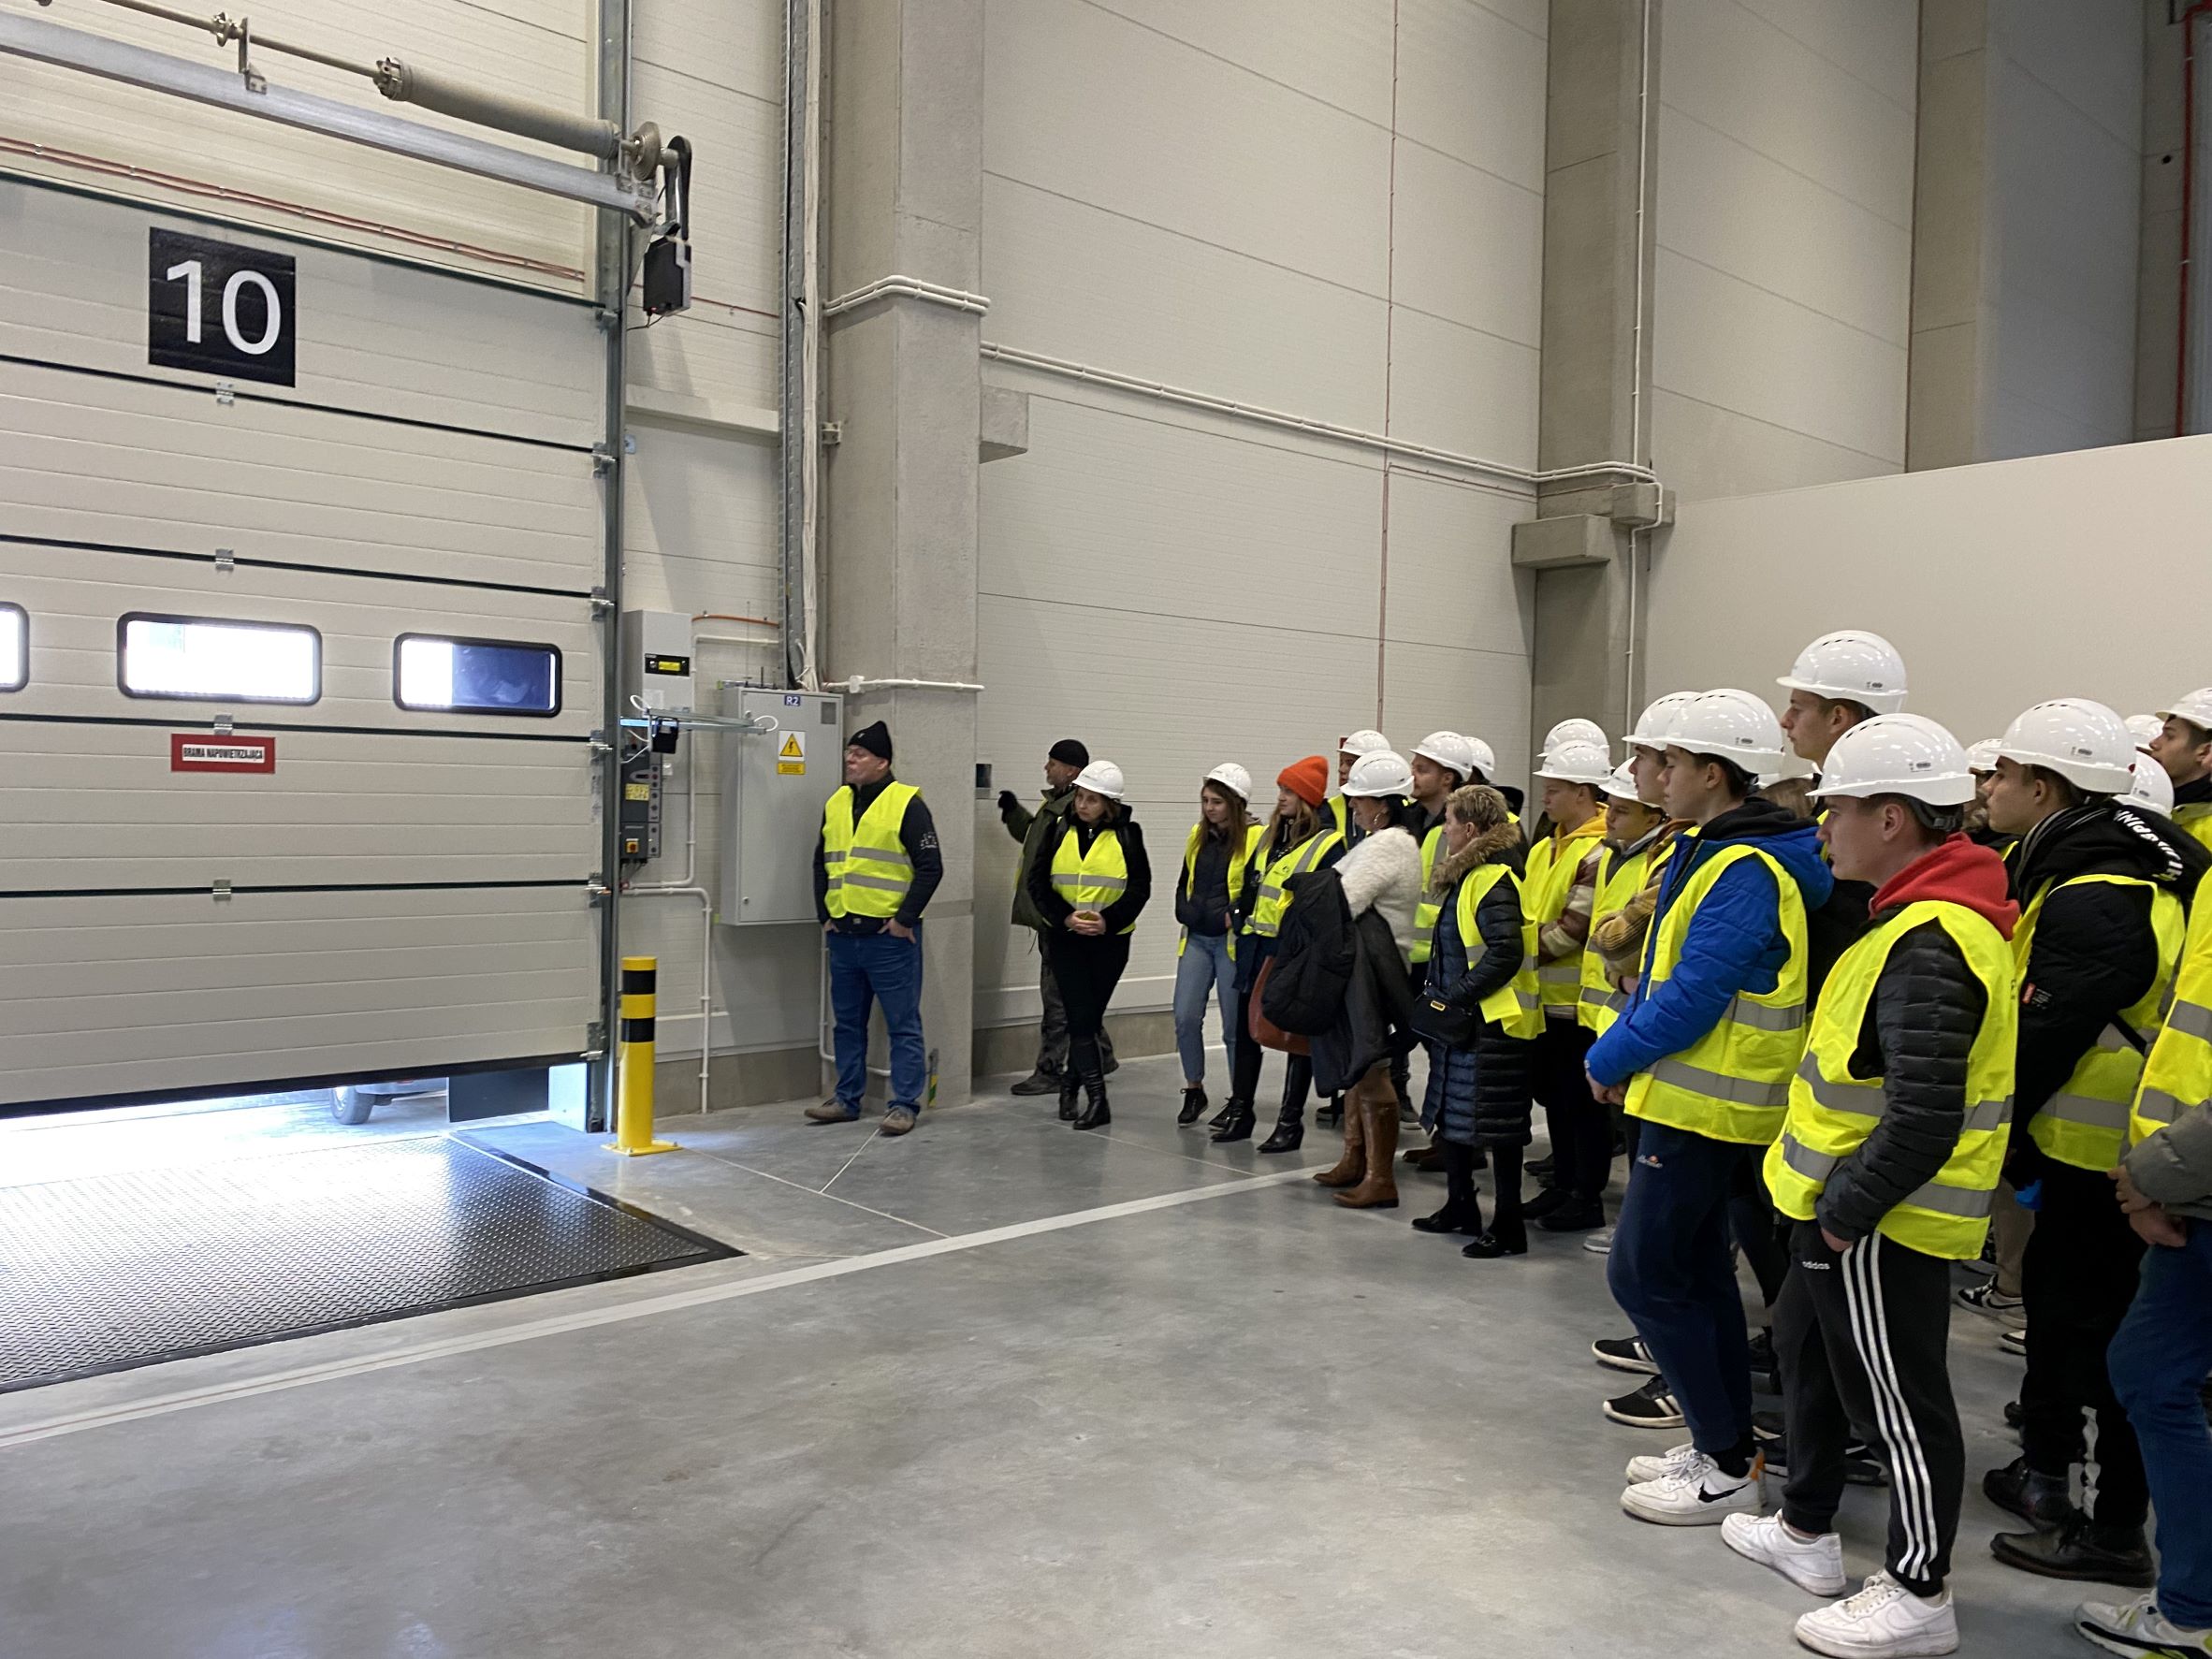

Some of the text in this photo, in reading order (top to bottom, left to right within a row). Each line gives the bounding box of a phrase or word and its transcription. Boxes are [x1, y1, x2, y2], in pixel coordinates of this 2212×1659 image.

[167, 259, 281, 356] 10
[786, 696, 799, 706] R2
[183, 748, 205, 758] BRAMA
